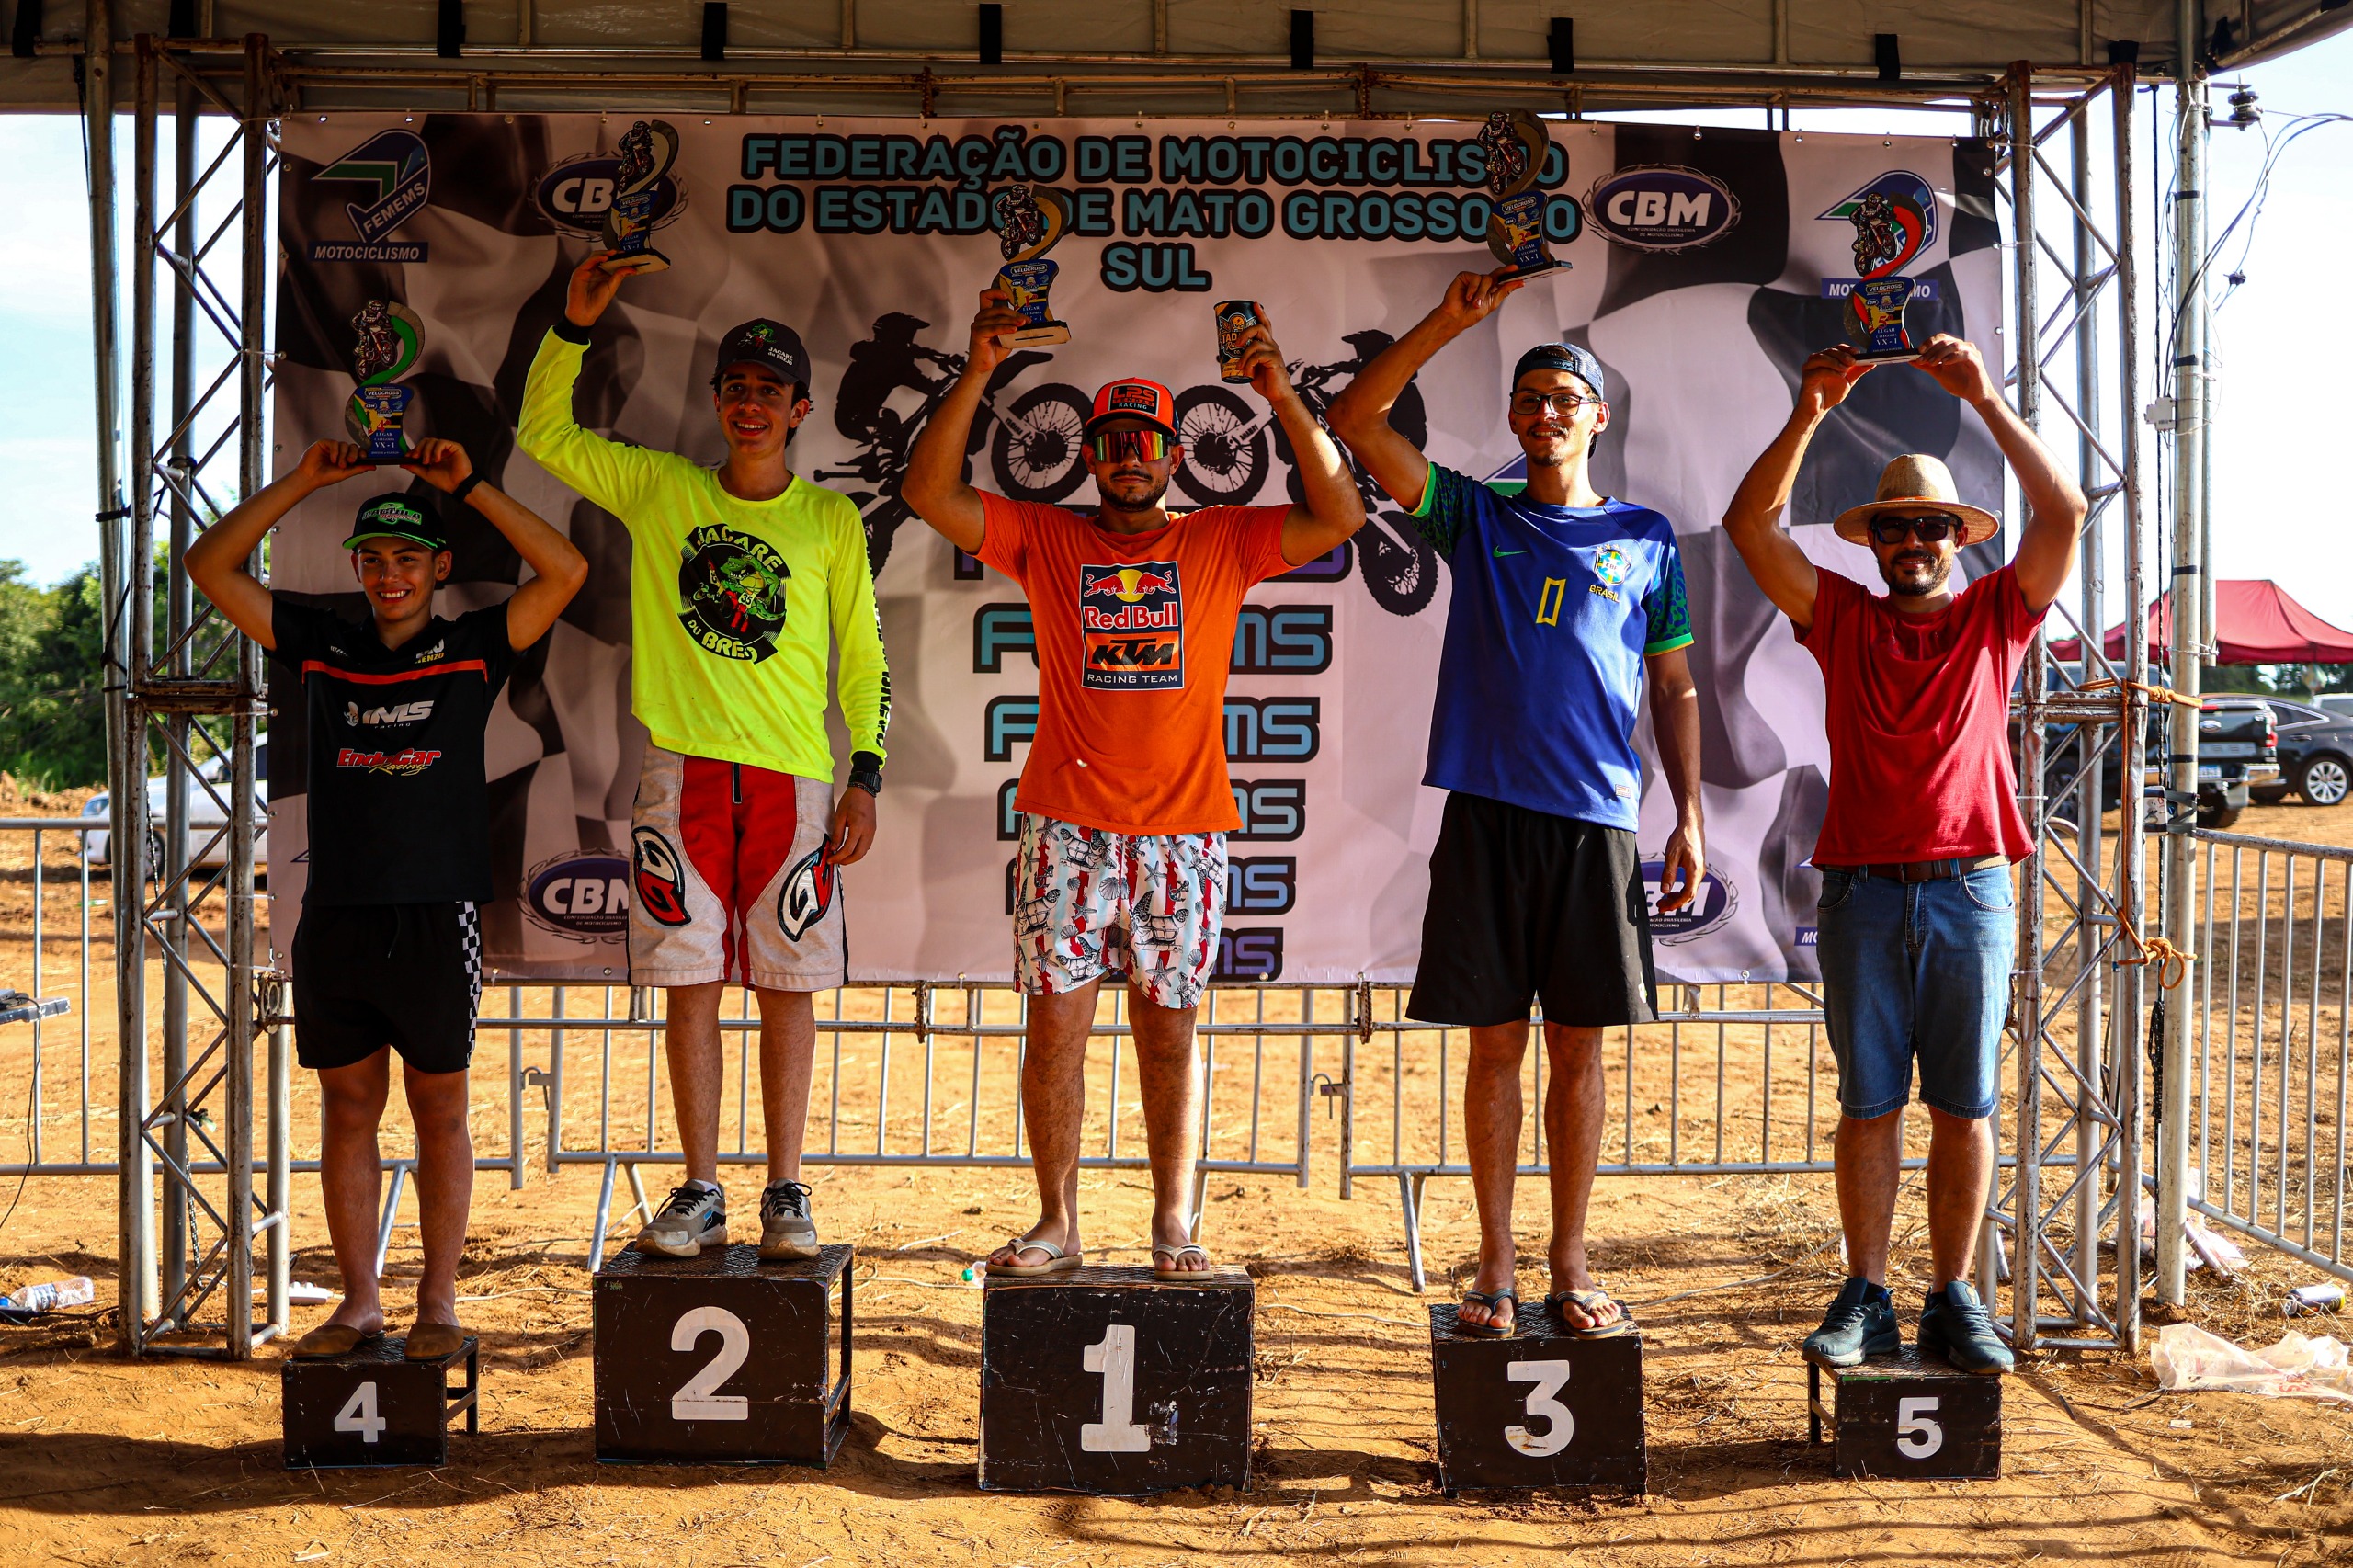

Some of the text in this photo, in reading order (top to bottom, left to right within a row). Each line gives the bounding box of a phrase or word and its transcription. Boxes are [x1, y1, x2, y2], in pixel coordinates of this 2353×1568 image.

[745, 131, 1563, 189] FEDERAÇÃO DE MOTOCICLISO
[363, 182, 426, 234] FEMEMS
[552, 178, 614, 213] CB
[1504, 199, 1535, 211] VELOCROSS
[1607, 190, 1711, 227] CBM
[732, 189, 800, 230] DO
[1129, 193, 1270, 233] MATO
[1289, 196, 1491, 237] GROSSO
[314, 246, 419, 260] MOTOCICLISMO
[1106, 247, 1207, 287] SUL
[1869, 284, 1903, 292] VELOCROSS
[768, 347, 793, 361] JACARÉ
[1113, 387, 1155, 402] LPS
[697, 526, 783, 572] JACARE
[740, 593, 753, 605] 35
[1589, 585, 1620, 603] BRASIL
[688, 620, 701, 635] DU
[1083, 602, 1178, 630] Red Bull
[1091, 638, 1175, 665] KTM
[1087, 674, 1177, 684] RACING TEAM
[362, 700, 434, 724] IMS
[369, 763, 428, 776] Racing
[671, 1305, 750, 1421] 2
[1081, 1324, 1151, 1452] 1
[334, 1381, 386, 1443] 4
[1504, 1359, 1575, 1458] 3
[1896, 1396, 1944, 1460] 5
